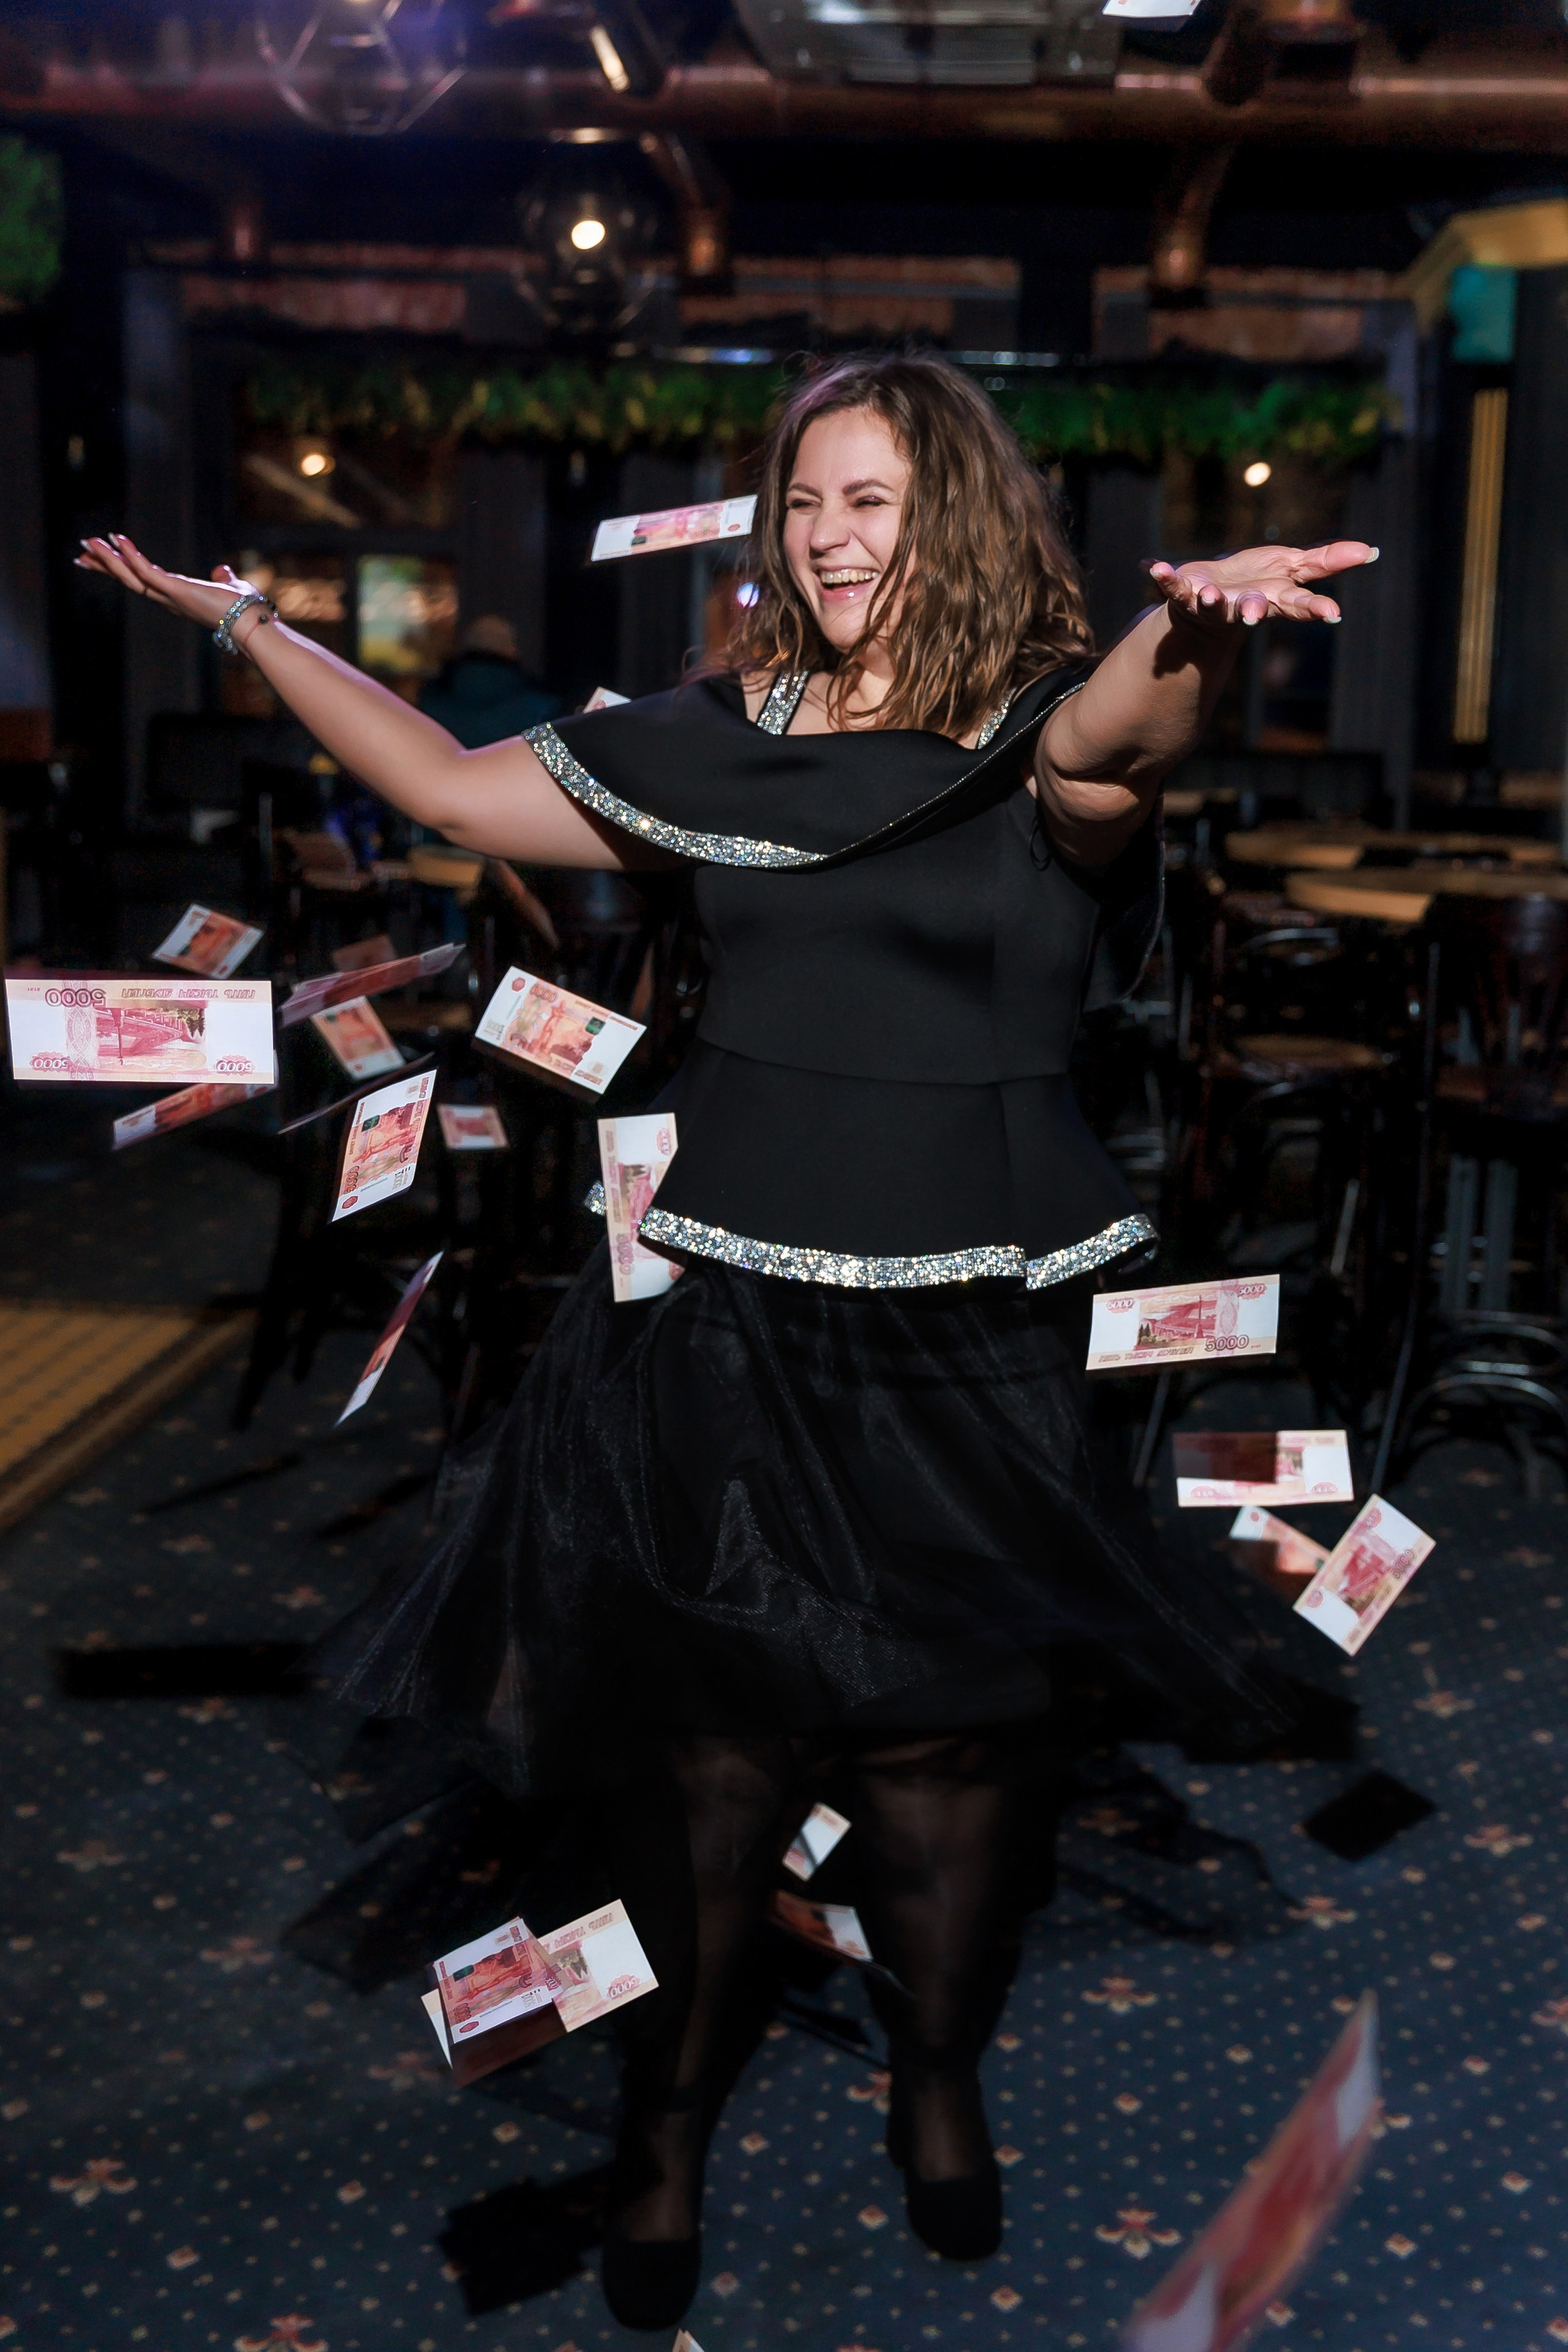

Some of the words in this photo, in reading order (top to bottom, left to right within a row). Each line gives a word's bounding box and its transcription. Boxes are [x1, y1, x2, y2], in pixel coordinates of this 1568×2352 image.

[45, 988, 107, 1006] 5000
[121, 988, 173, 999] ДУБЛЕЙ
[178, 988, 219, 1000] ТЫСЯЧ
[224, 989, 256, 1000] ПЯТЬ
[33, 1058, 69, 1069] 5000
[216, 1060, 253, 1071] 5000
[1205, 1335, 1250, 1352] 5000
[609, 1977, 640, 1999] 5000
